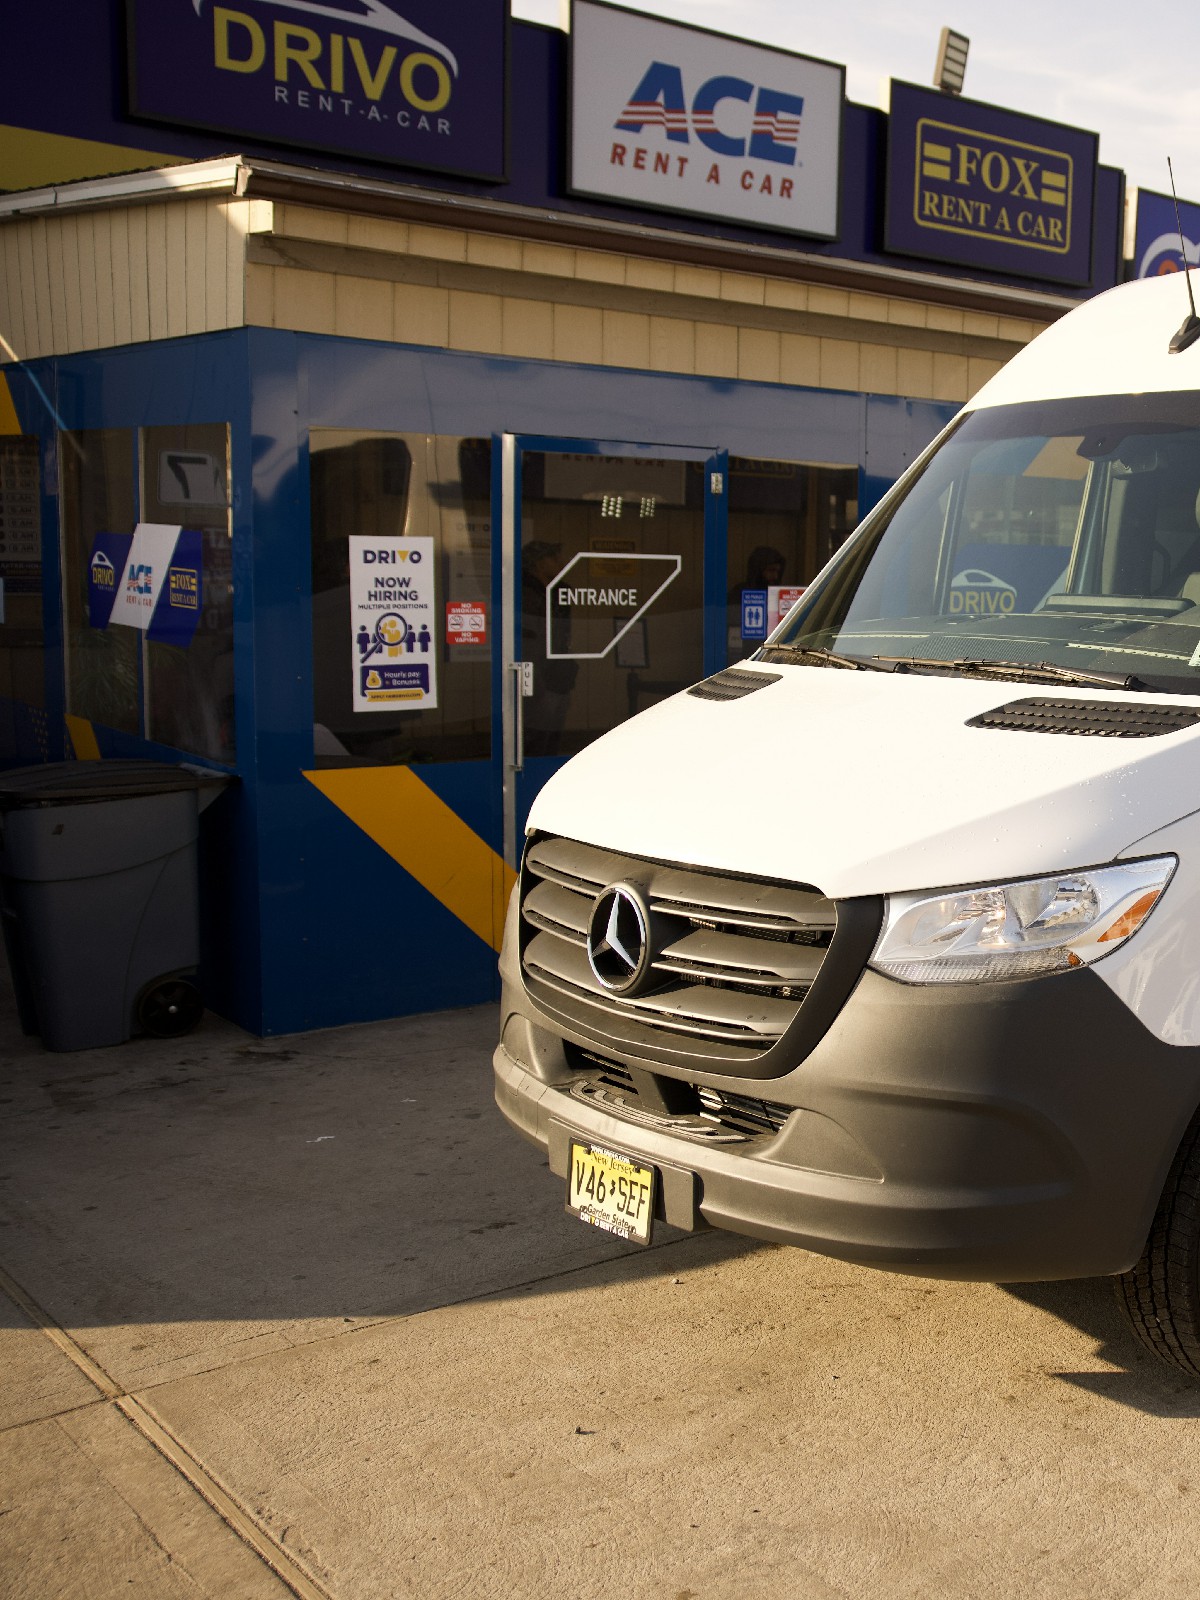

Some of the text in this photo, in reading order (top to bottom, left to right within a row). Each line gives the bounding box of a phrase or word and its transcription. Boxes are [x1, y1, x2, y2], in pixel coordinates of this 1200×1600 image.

[214, 6, 451, 113] DRIVO
[614, 60, 804, 166] ACE
[610, 142, 794, 199] RENT A CAR
[955, 143, 1040, 201] FOX
[923, 190, 1064, 243] RENT A CAR
[363, 550, 422, 564] DRIVO
[93, 567, 114, 586] DRIVO
[127, 564, 152, 594] ACE
[175, 573, 191, 591] FOX
[374, 577, 411, 588] NOW
[368, 590, 418, 601] HIRING
[558, 588, 637, 606] ENTRANCE
[949, 591, 1015, 613] DRIVO
[592, 1151, 608, 1165] New
[609, 1157, 635, 1176] Jersey
[587, 1204, 629, 1230] Garden State
